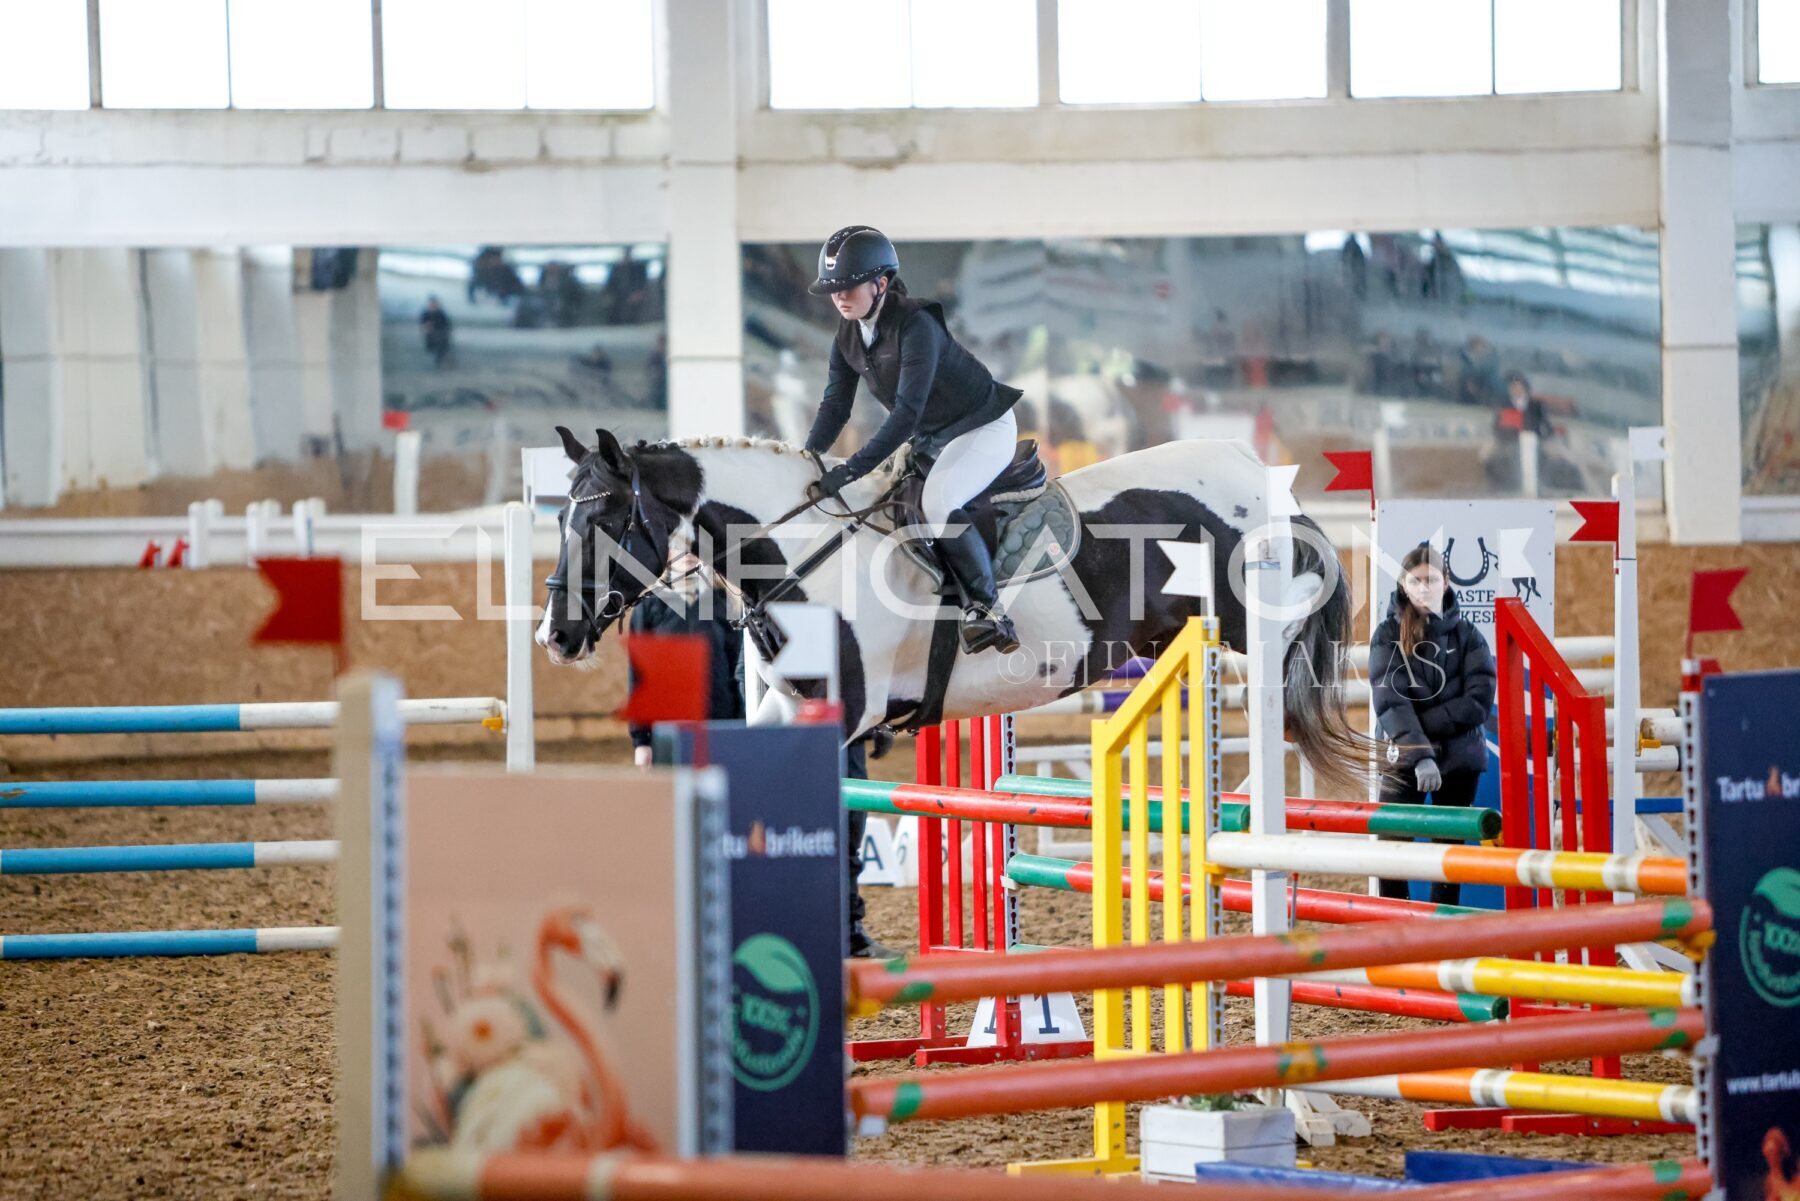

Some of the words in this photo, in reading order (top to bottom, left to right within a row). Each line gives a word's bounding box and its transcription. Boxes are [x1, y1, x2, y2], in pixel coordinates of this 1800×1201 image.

[1456, 589, 1496, 603] ASTE
[1781, 772, 1800, 799] br
[863, 834, 884, 871] A
[1033, 990, 1060, 1034] 1
